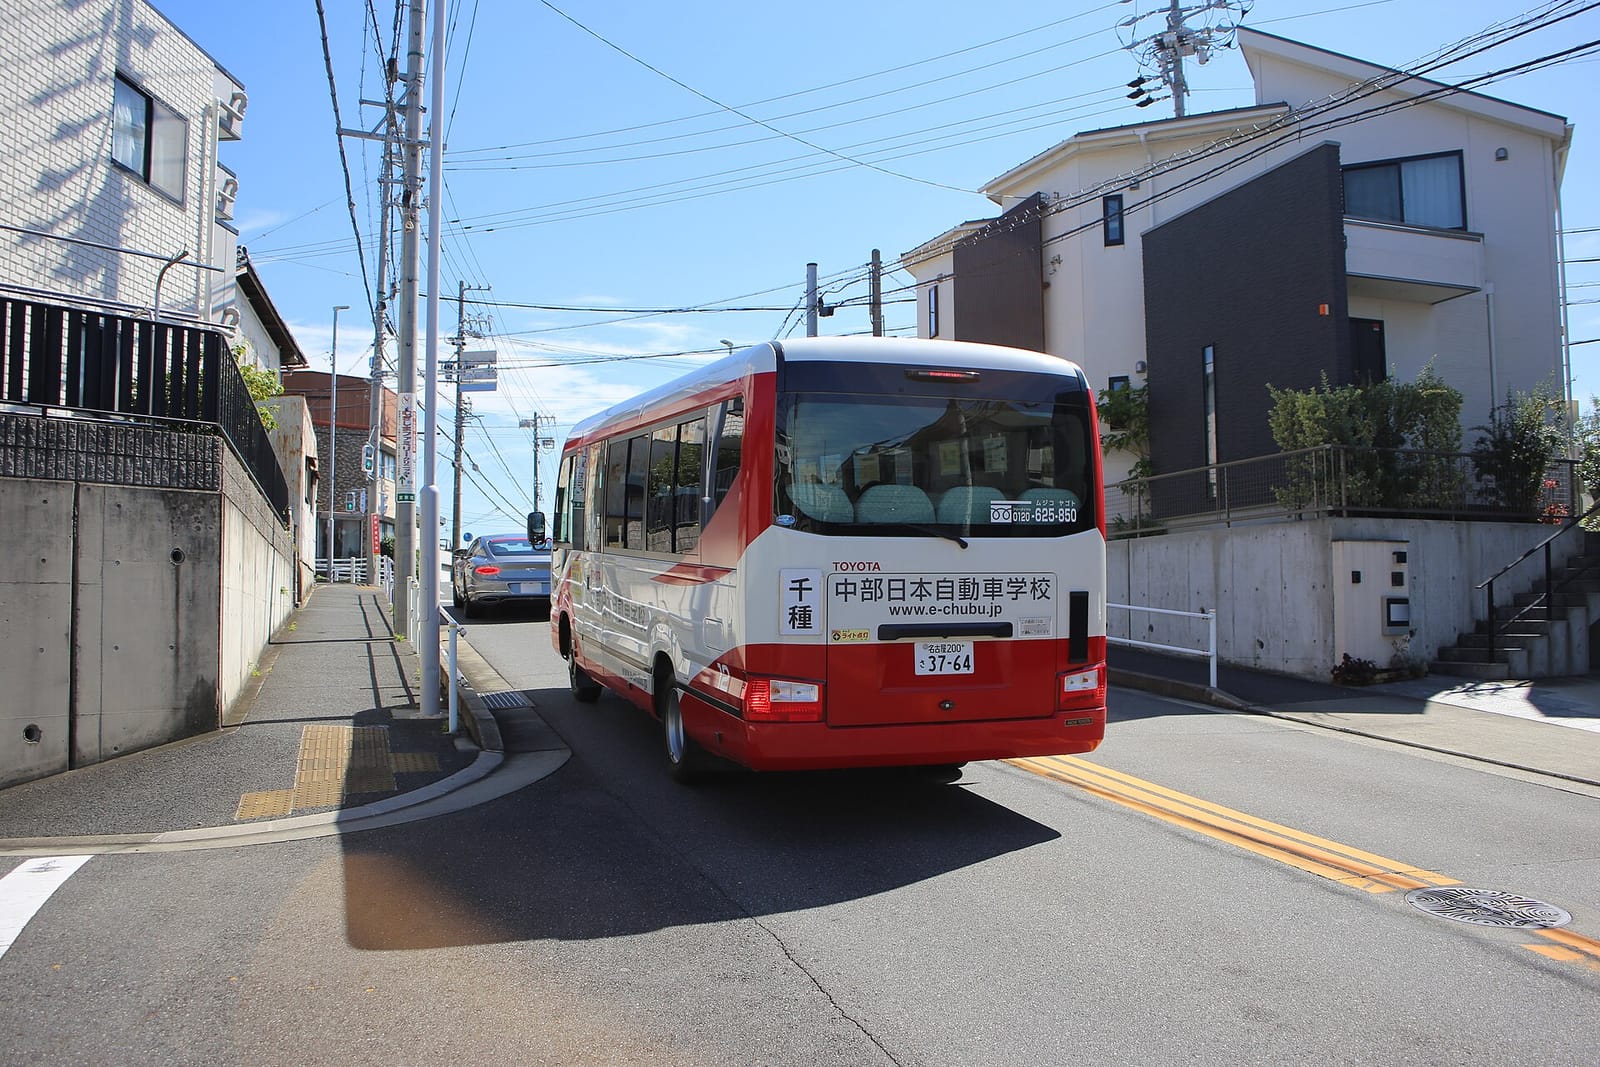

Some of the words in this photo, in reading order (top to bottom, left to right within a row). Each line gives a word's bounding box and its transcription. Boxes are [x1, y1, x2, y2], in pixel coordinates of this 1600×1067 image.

[833, 562, 881, 571] TOYOTA
[835, 577, 1051, 602] 中部日本自動車学校
[788, 577, 813, 630] 千種
[889, 602, 1002, 617] www.e-chubu.jp
[919, 660, 925, 669] さ
[928, 654, 971, 672] 37-64
